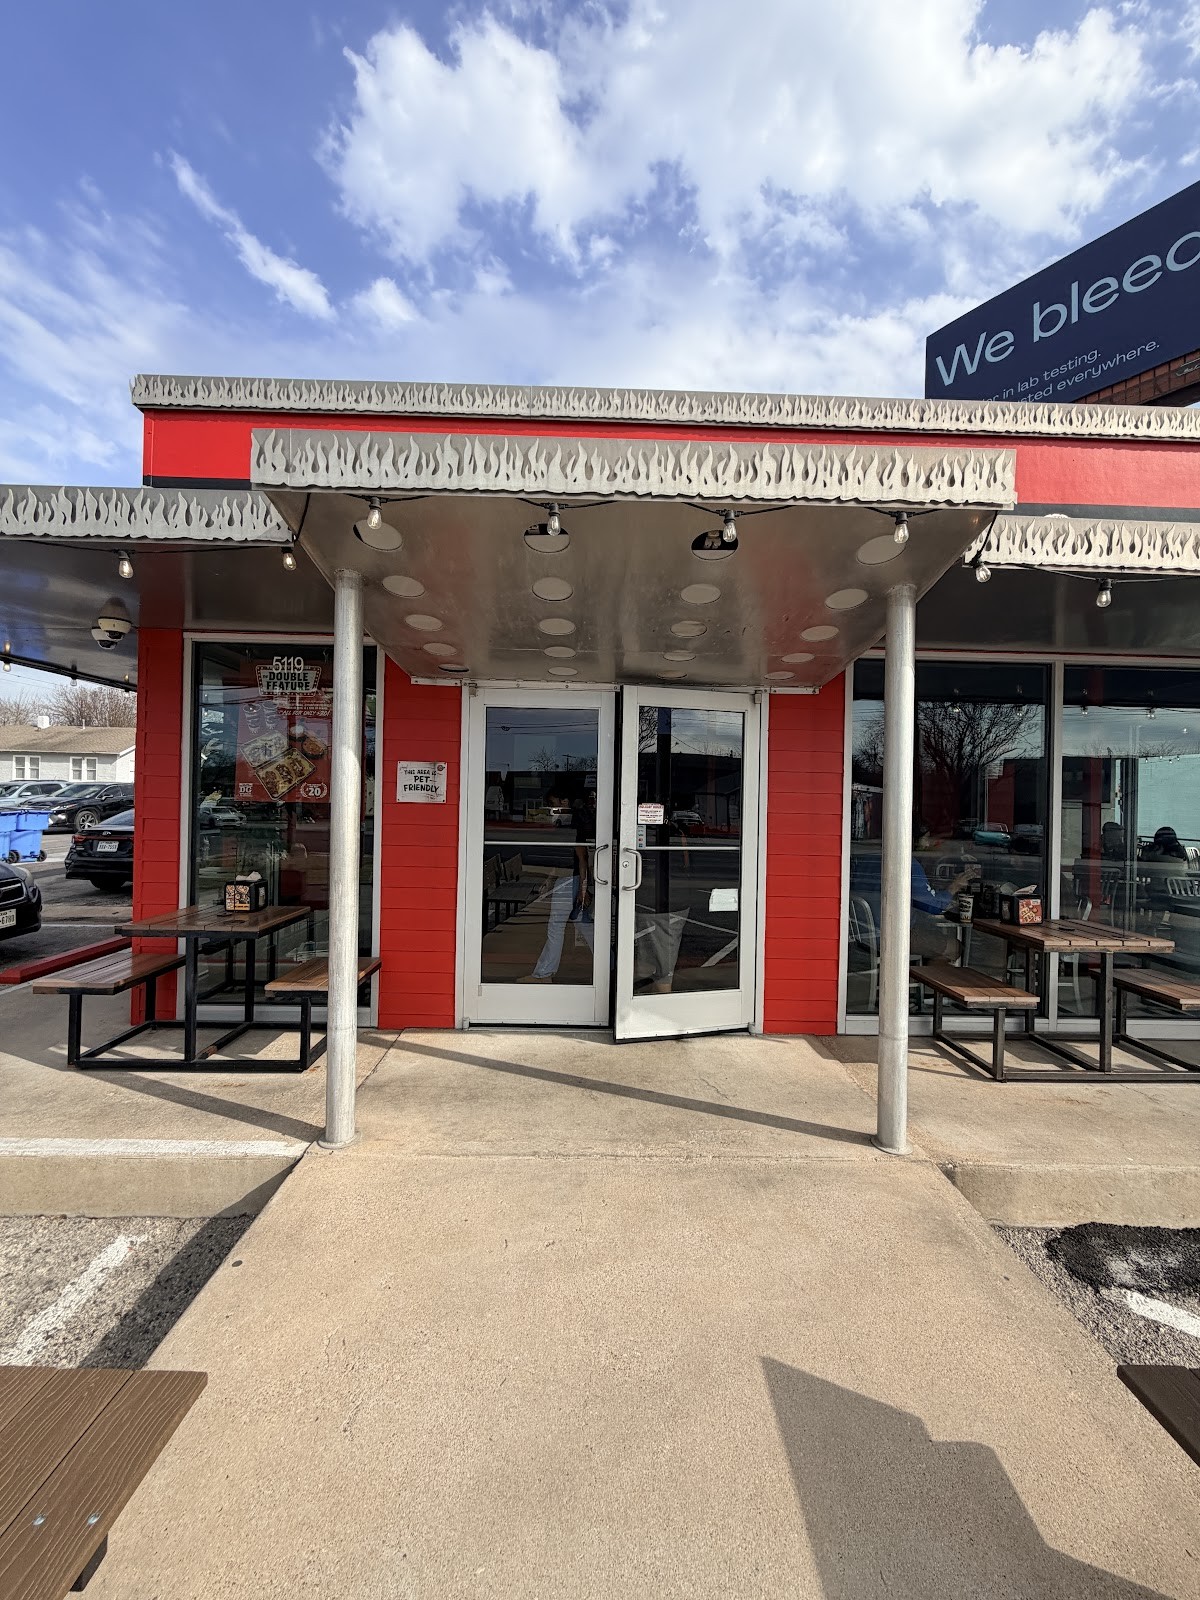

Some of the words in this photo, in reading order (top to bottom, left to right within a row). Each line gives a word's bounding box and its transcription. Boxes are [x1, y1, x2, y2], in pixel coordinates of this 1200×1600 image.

[935, 331, 1015, 387] We
[1057, 341, 1160, 391] everywhere.
[1003, 389, 1014, 400] in
[1018, 377, 1039, 393] lab
[1043, 350, 1102, 380] testing.
[272, 656, 304, 673] 5119
[269, 672, 309, 681] DOUBLE
[266, 681, 310, 691] FEATURE
[403, 784, 439, 793] FRIENDLY
